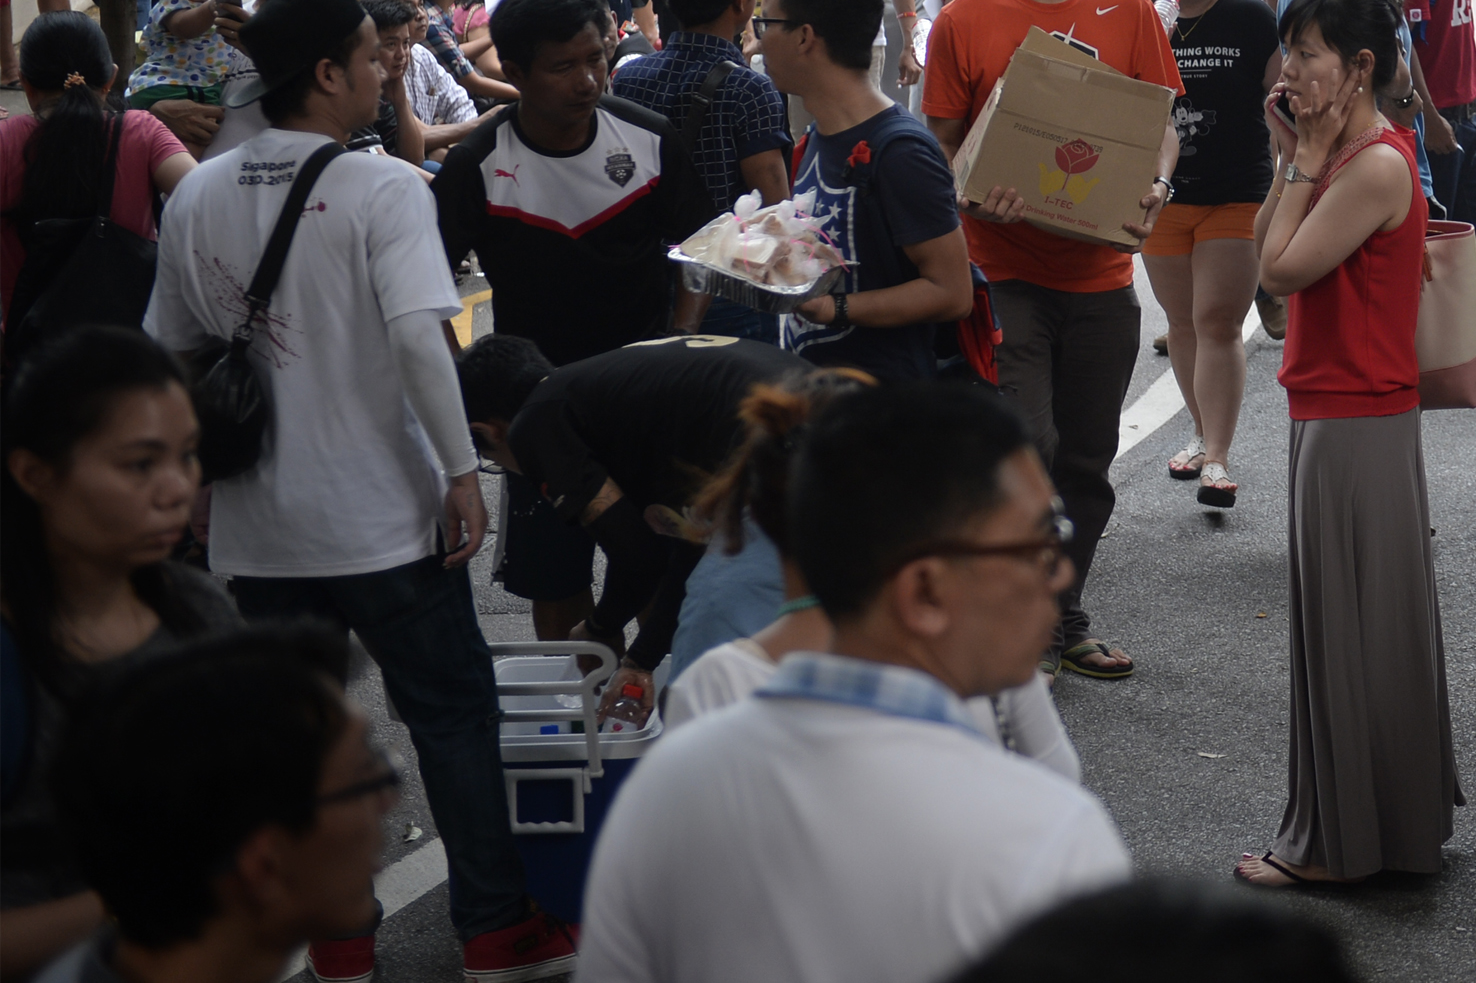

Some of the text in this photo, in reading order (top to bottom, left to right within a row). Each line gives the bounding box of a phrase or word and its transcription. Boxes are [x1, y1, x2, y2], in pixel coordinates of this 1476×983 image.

[1204, 46, 1241, 57] WORKS
[1177, 58, 1234, 68] CHANGE IT
[1044, 195, 1074, 210] I-TEC
[1026, 204, 1056, 220] Drinking
[1057, 213, 1077, 225] Water
[1077, 219, 1099, 231] 500ml
